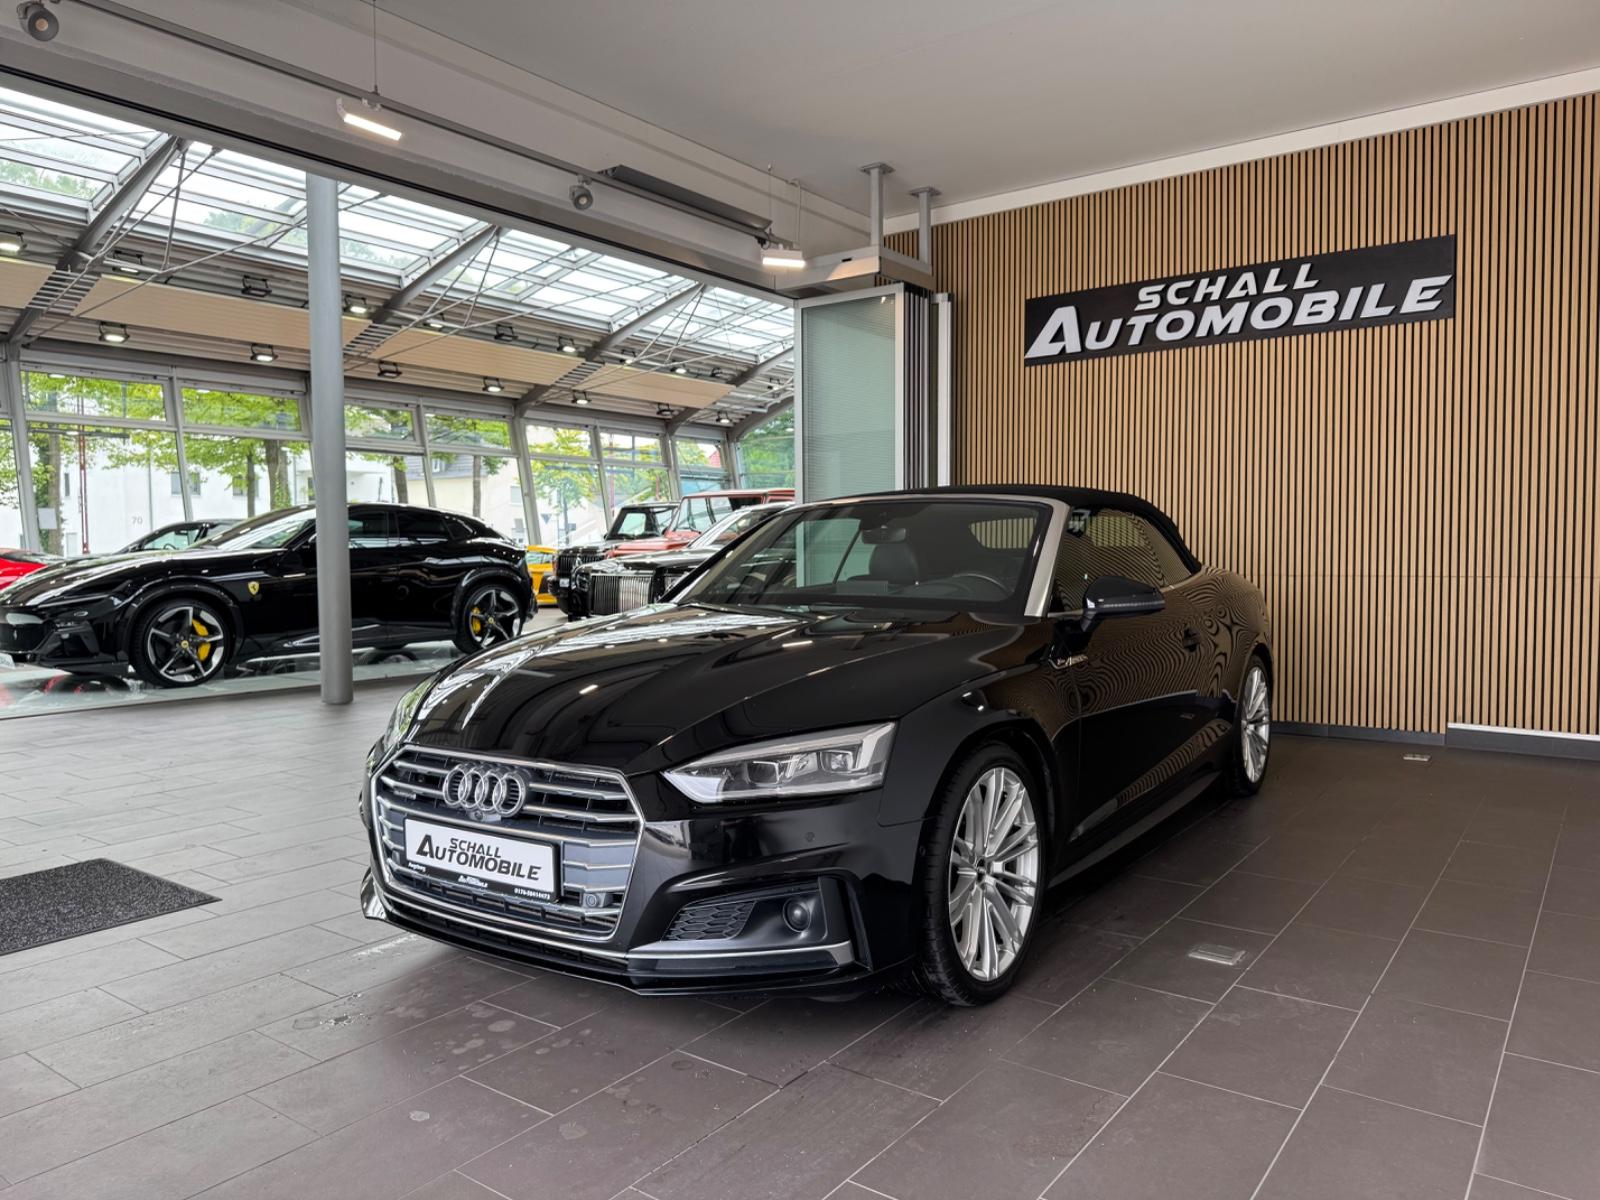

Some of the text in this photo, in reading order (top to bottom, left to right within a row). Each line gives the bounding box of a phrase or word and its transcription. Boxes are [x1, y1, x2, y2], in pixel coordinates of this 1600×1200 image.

[1134, 263, 1320, 312] SCHALL
[1024, 274, 1453, 360] AUTOMOBILE
[416, 833, 542, 881] AUTOMOBILE
[449, 837, 502, 859] SCHALL
